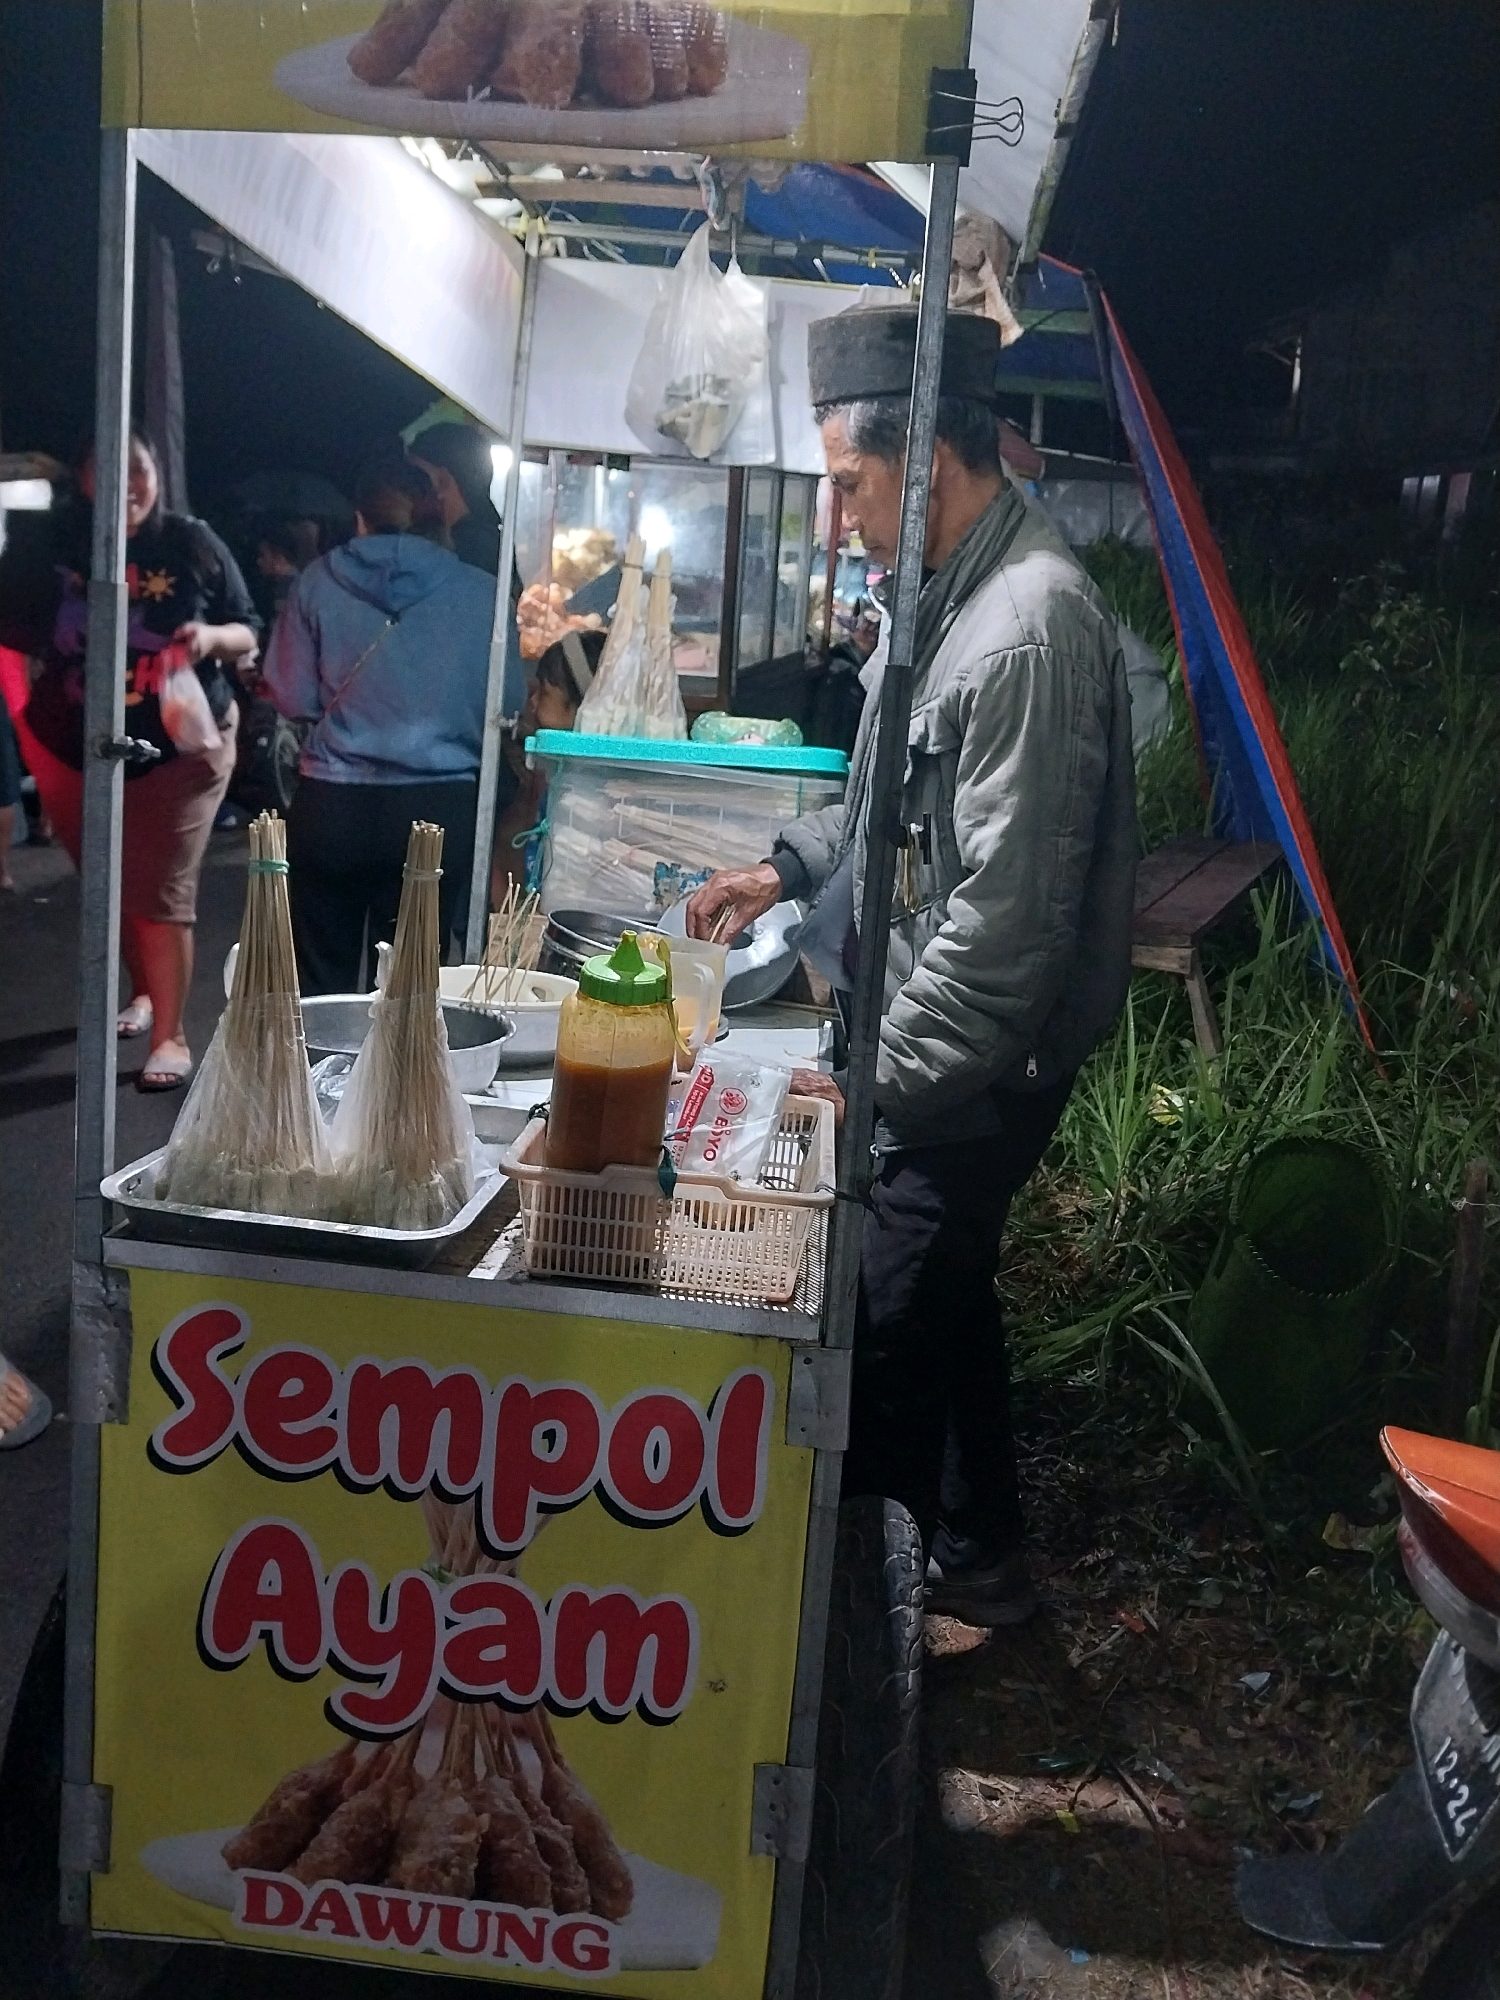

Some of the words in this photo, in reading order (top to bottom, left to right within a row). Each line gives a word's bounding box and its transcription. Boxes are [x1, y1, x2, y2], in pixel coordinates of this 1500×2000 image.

[147, 1300, 774, 1560] Sempol
[196, 1516, 698, 1742] Ayam
[240, 1874, 611, 1973] DAWUNG
